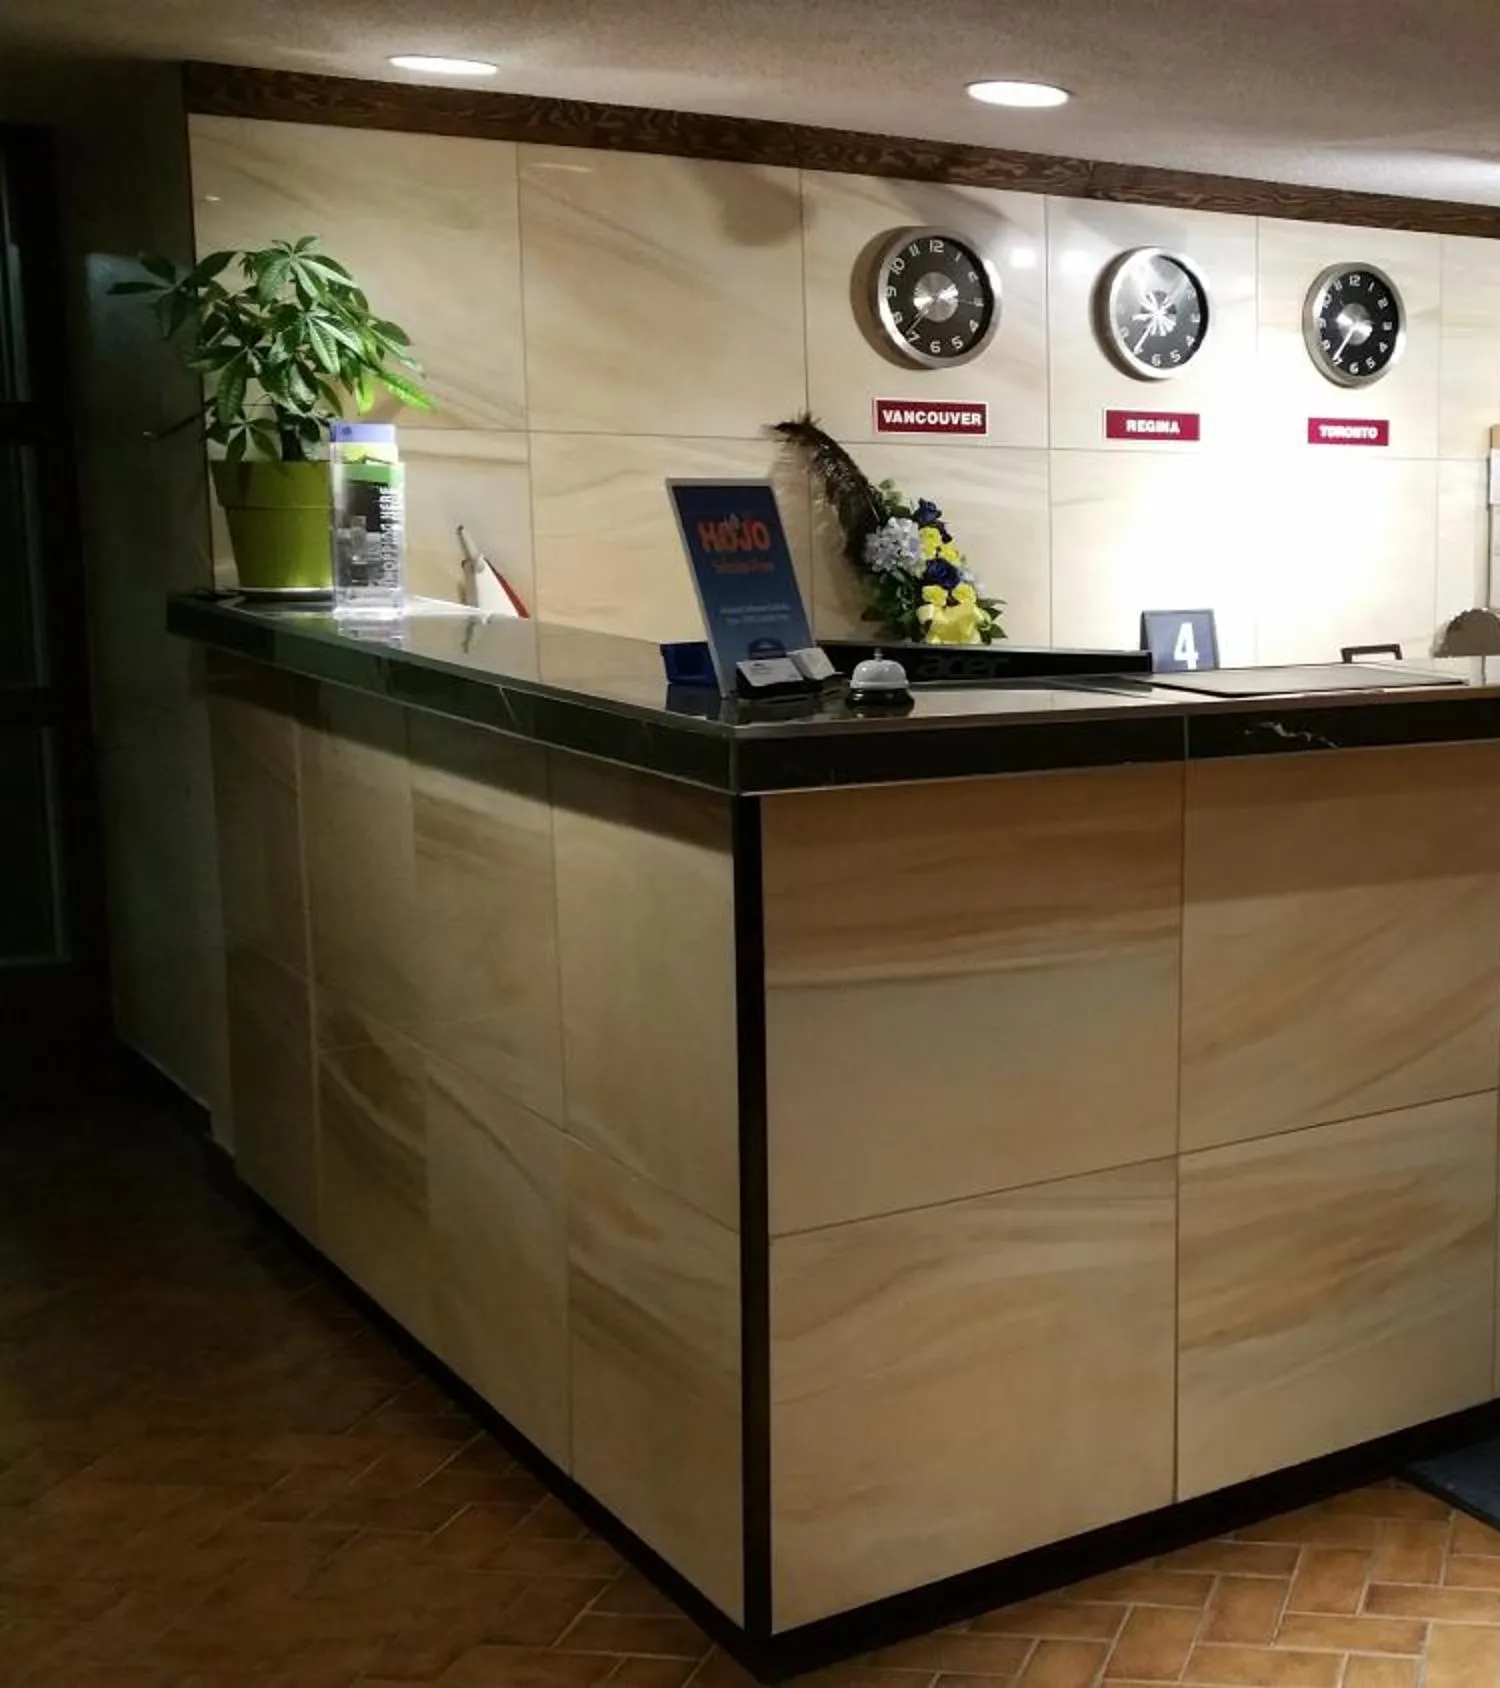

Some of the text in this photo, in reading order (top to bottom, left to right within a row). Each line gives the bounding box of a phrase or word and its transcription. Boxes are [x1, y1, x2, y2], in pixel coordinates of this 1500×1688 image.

[908, 243, 920, 257] 11
[928, 239, 944, 253] 12
[889, 257, 905, 275] 10
[1349, 274, 1361, 287] 12
[969, 319, 979, 333] 4
[930, 341, 941, 353] 6
[951, 335, 964, 349] 5
[1379, 341, 1389, 353] 4
[1152, 353, 1162, 366] 6
[1349, 361, 1360, 375] 6
[882, 409, 982, 426] VANCOUVER
[1126, 419, 1181, 434] REGINA
[1318, 425, 1378, 439] TORONTO
[1174, 621, 1199, 670] 4
[916, 653, 1010, 678] acer
